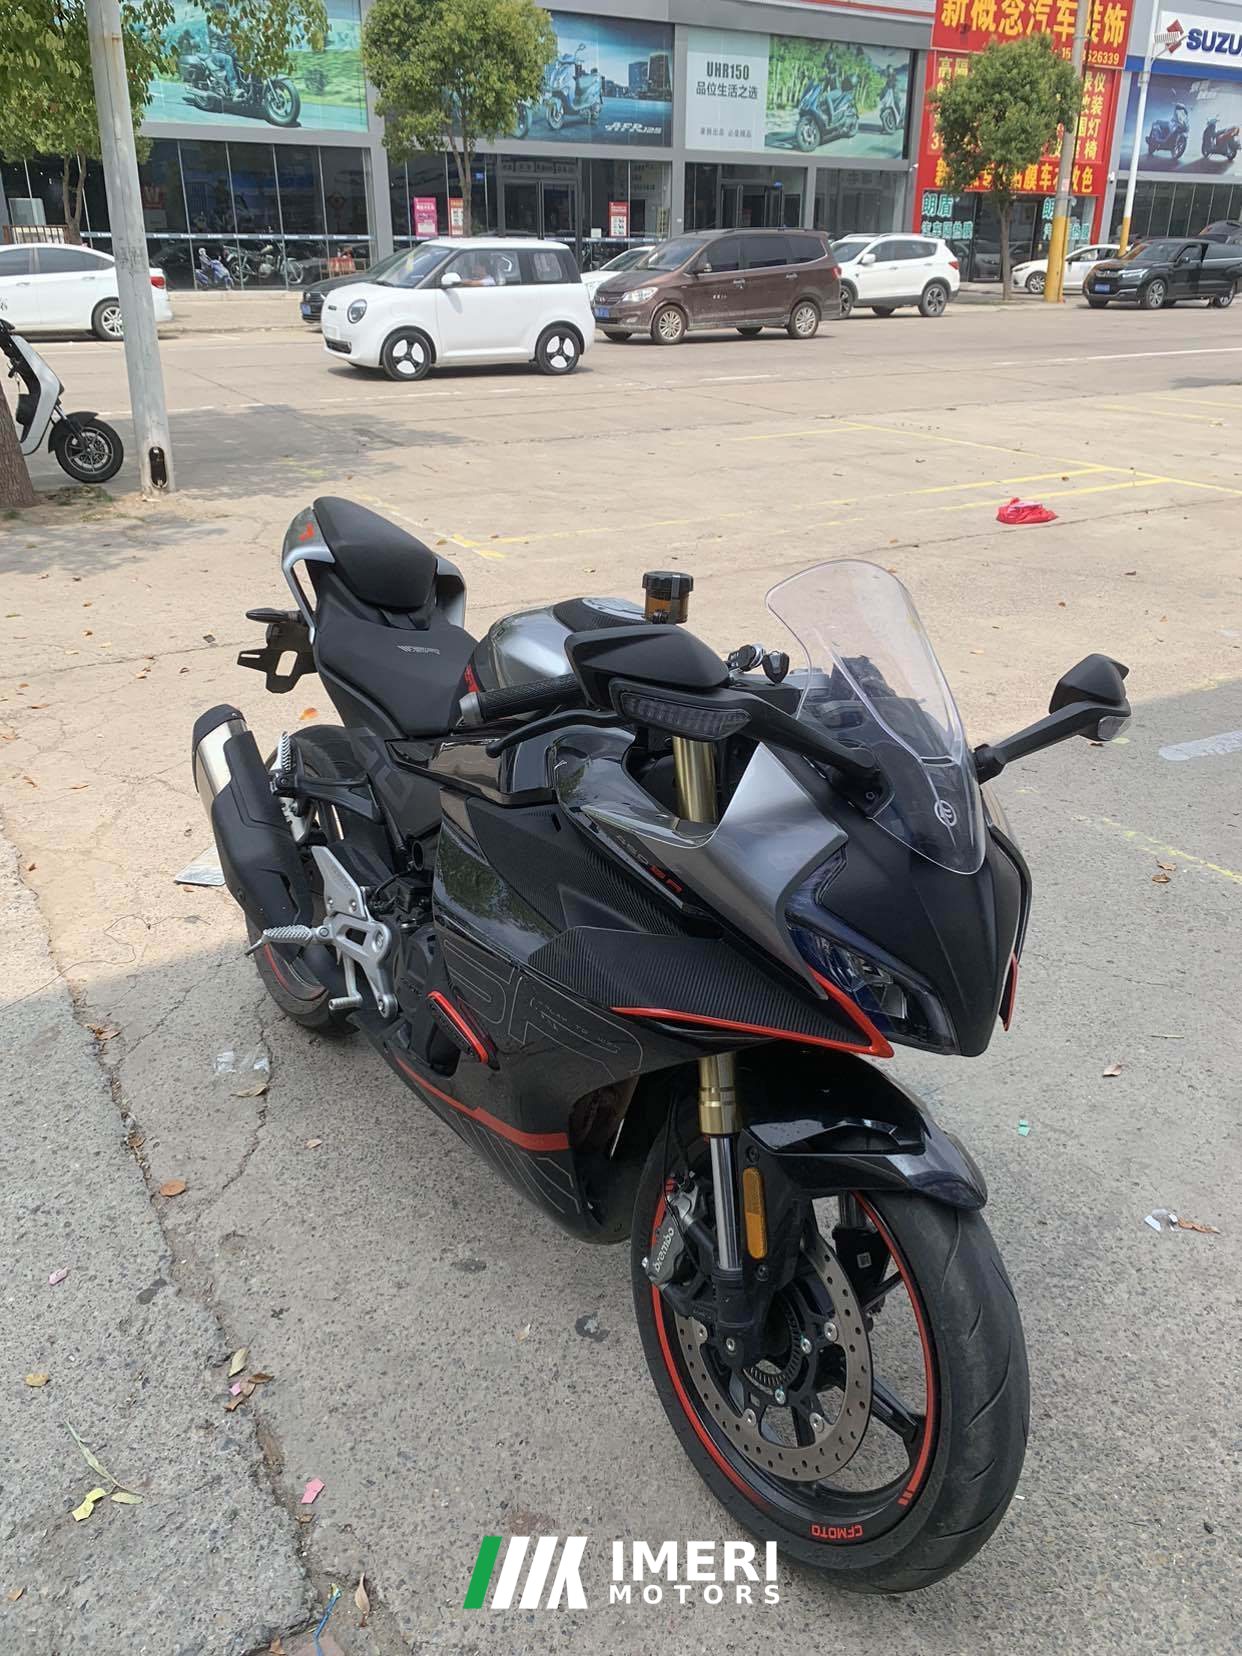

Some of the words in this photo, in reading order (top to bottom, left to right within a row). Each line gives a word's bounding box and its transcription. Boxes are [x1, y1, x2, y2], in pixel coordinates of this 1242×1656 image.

[706, 61, 751, 81] UHR150
[696, 81, 758, 100] 品位生活之选
[653, 1227, 675, 1273] brembo
[810, 1524, 864, 1540] CFMOTO
